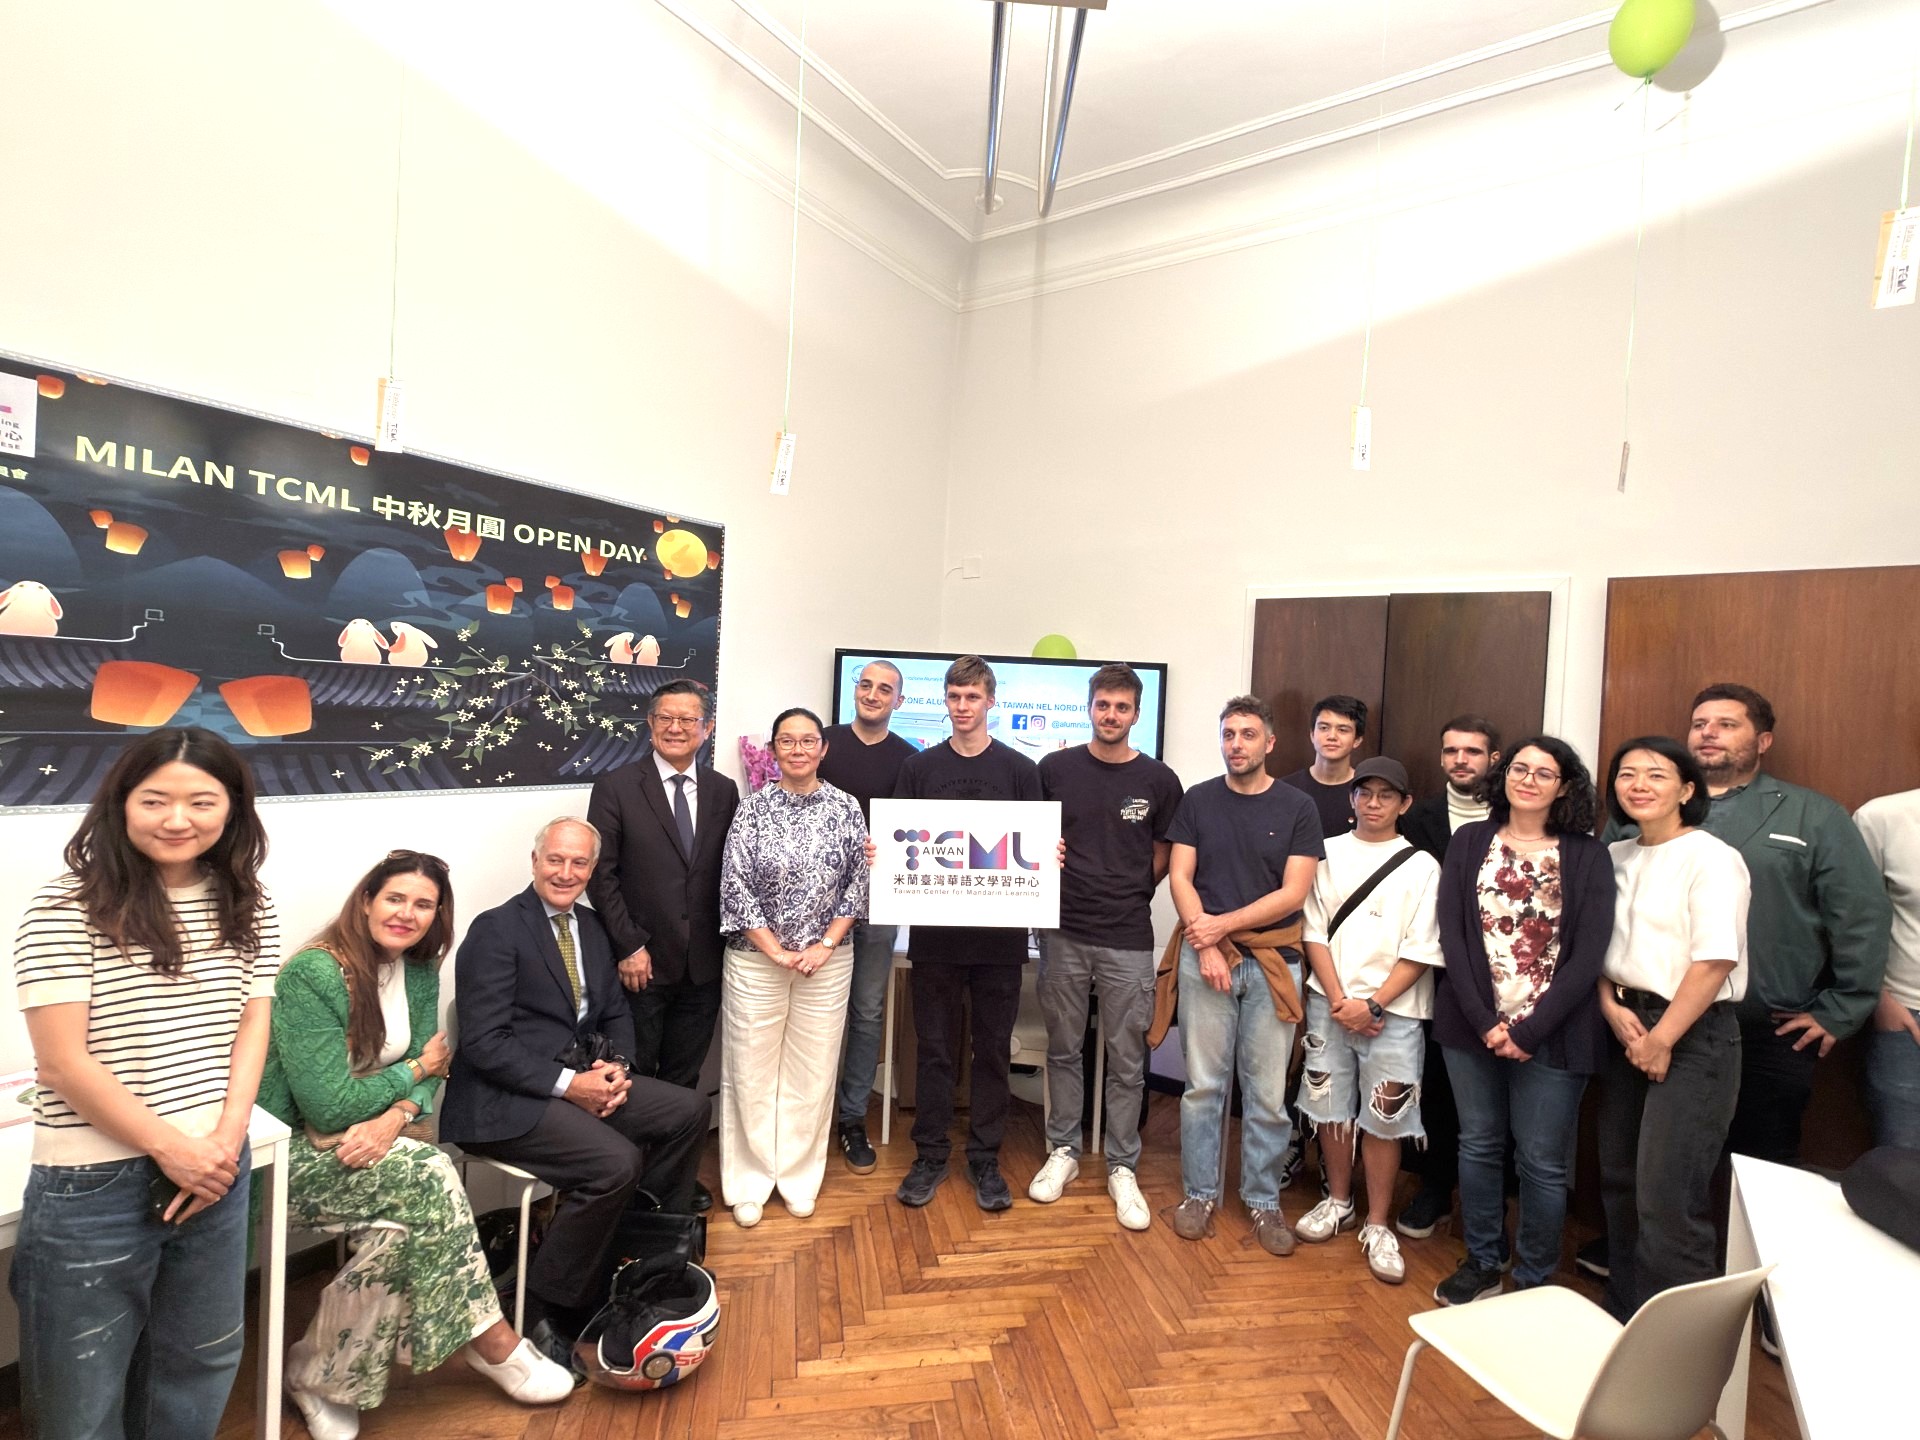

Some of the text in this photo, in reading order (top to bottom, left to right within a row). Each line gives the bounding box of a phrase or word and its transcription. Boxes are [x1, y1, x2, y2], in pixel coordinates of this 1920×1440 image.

[0, 430, 23, 441] 心
[76, 435, 645, 563] MILAN TCML 中秋月圓 OPEN DAY
[1002, 702, 1034, 710] TAIWAN
[1055, 704, 1078, 712] NORD
[893, 829, 1040, 871] TCML
[893, 874, 1040, 888] 米蘭臺灣華語文學習中心
